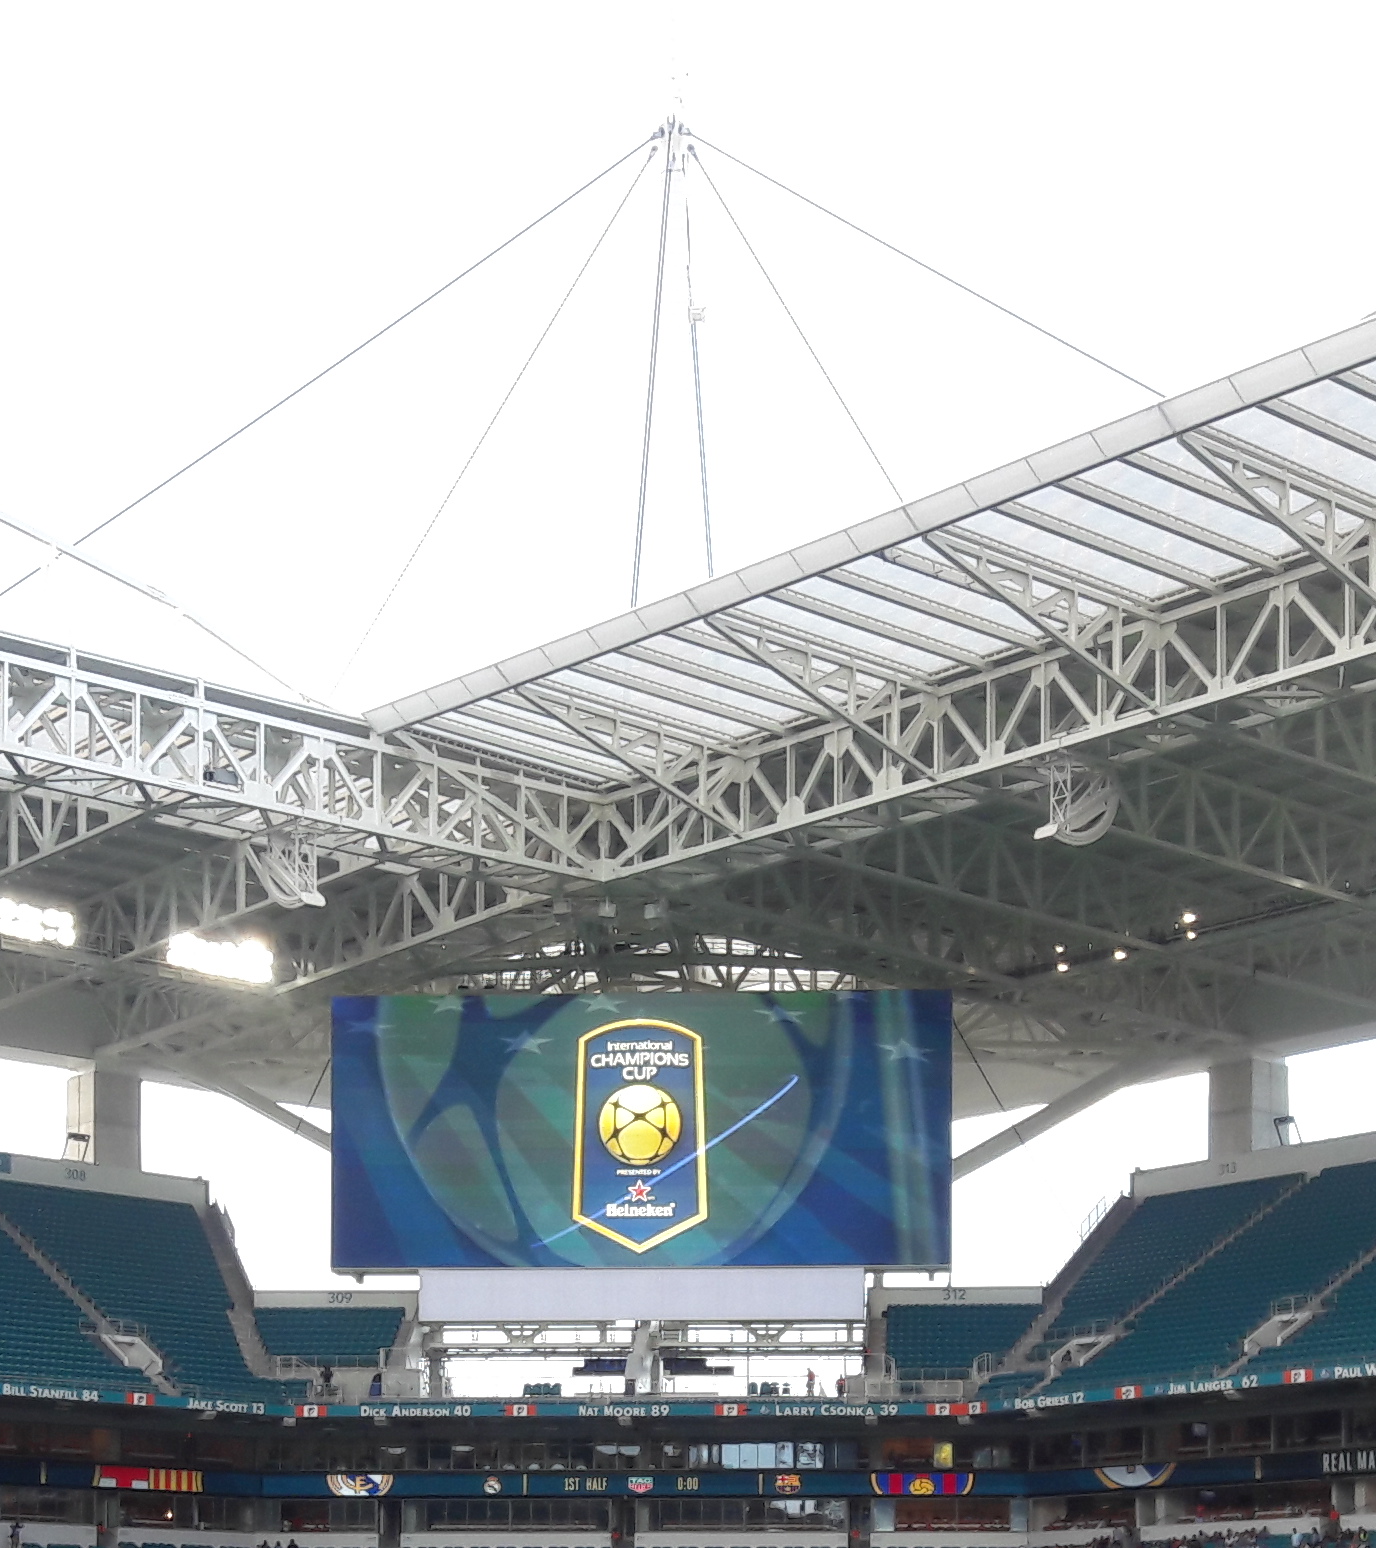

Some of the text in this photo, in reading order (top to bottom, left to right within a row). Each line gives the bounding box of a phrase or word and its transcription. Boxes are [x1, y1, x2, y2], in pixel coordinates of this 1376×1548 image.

[607, 1040, 673, 1051] International
[590, 1052, 689, 1067] CHAMPIONS
[622, 1067, 657, 1080] CUP
[606, 1202, 674, 1217] Heineken
[328, 1292, 352, 1304] 309
[943, 1289, 966, 1300] 312
[1333, 1365, 1362, 1380] PAUL
[1167, 1374, 1259, 1395] JIM LANGER 62
[2, 1384, 99, 1402] BILL STANFILL 84
[187, 1399, 265, 1415] JAKE SCOTT 13
[1014, 1392, 1084, 1410] BOB GRIESE 12
[360, 1405, 471, 1418] DICK ANDERSON 40
[578, 1405, 670, 1418] NAT MOORE 89
[775, 1404, 898, 1418] LARRY CSONKA 39
[1323, 1452, 1352, 1473] REAL
[564, 1477, 580, 1491] 1ST
[677, 1477, 698, 1490] 0:00
